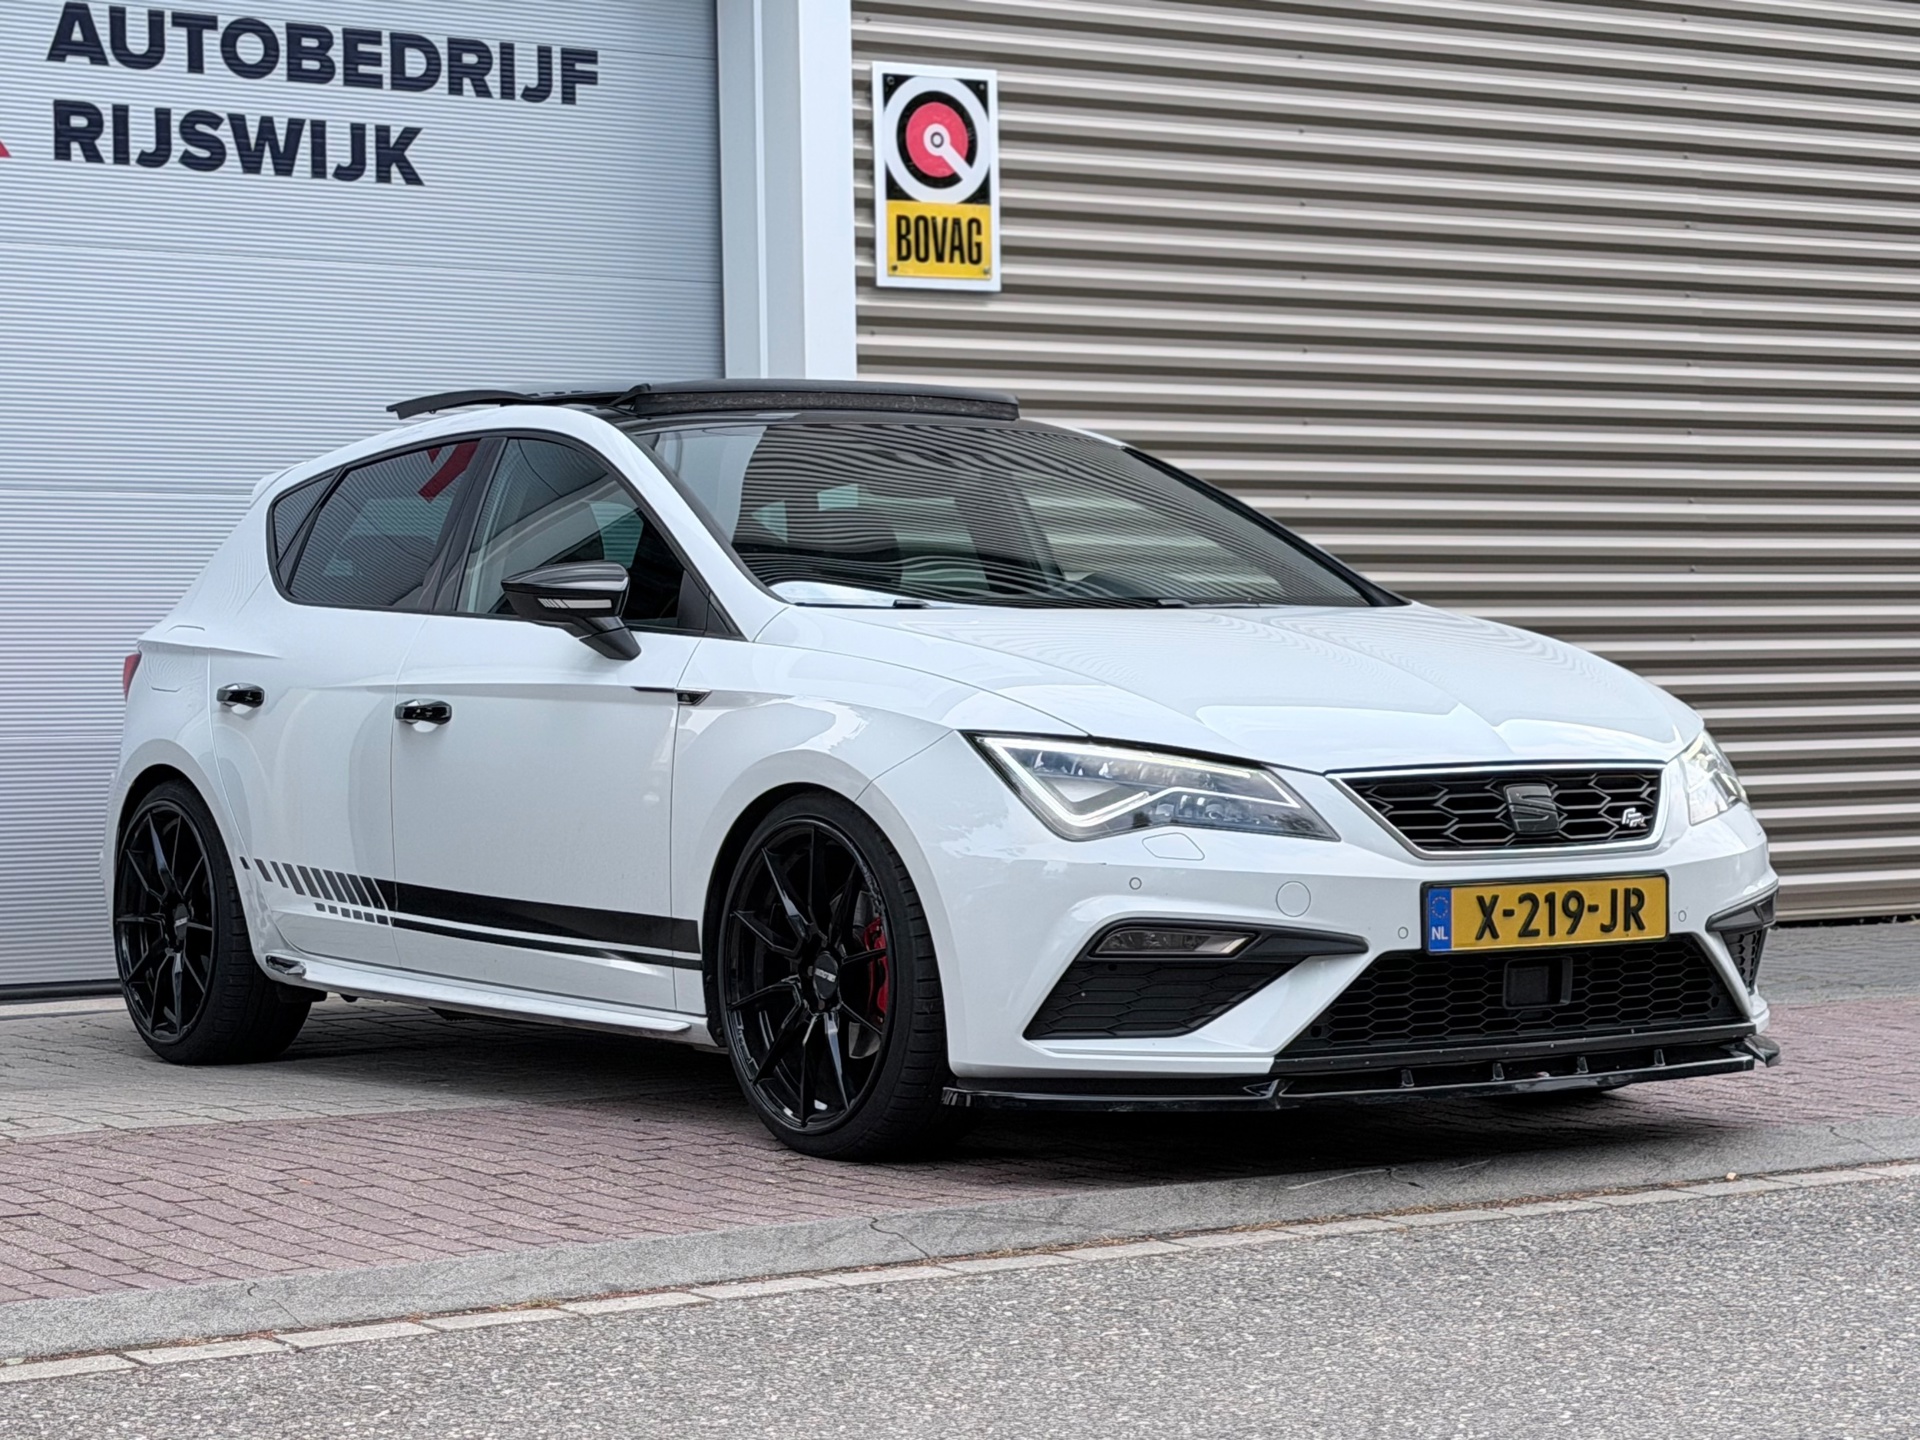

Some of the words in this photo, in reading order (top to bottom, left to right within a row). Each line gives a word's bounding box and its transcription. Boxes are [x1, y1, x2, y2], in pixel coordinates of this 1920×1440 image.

[46, 1, 598, 105] AUTOBEDRIJF
[53, 100, 425, 186] RIJSWIJK
[896, 214, 982, 265] BOVAG
[1431, 926, 1448, 940] NL
[1475, 887, 1646, 940] X-219-JR
